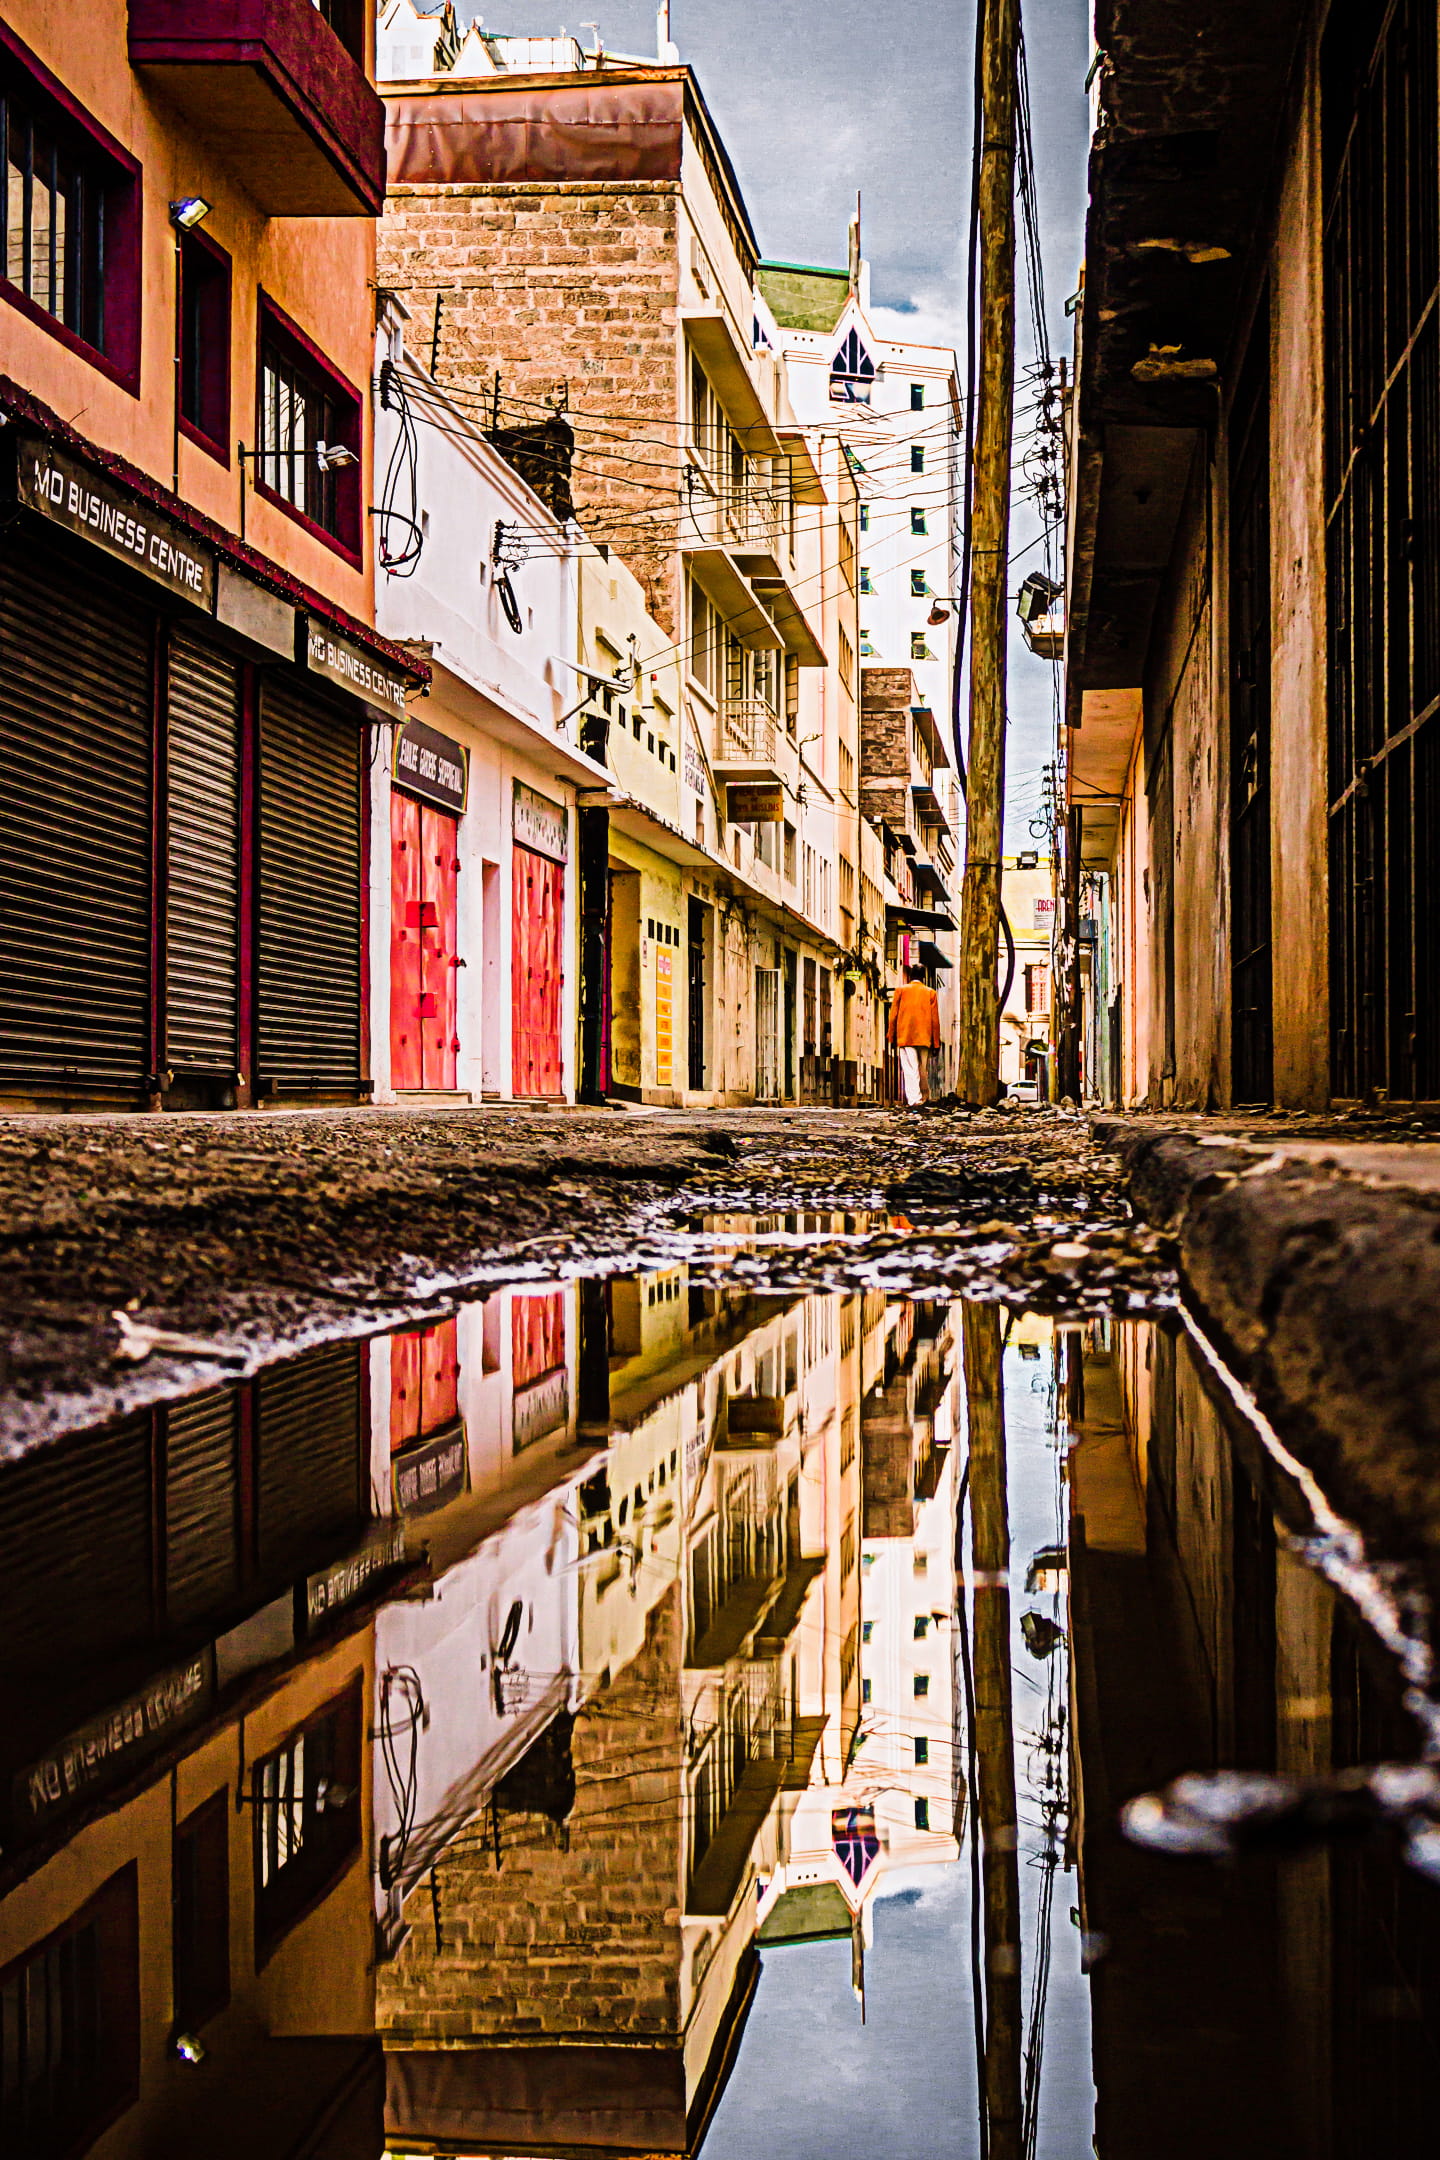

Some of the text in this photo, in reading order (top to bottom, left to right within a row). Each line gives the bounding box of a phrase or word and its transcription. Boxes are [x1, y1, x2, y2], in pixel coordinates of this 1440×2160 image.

[34, 459, 204, 593] MD BUSINESS CENTRE
[327, 642, 371, 689] BUSINESS
[372, 670, 406, 709] CENTRE
